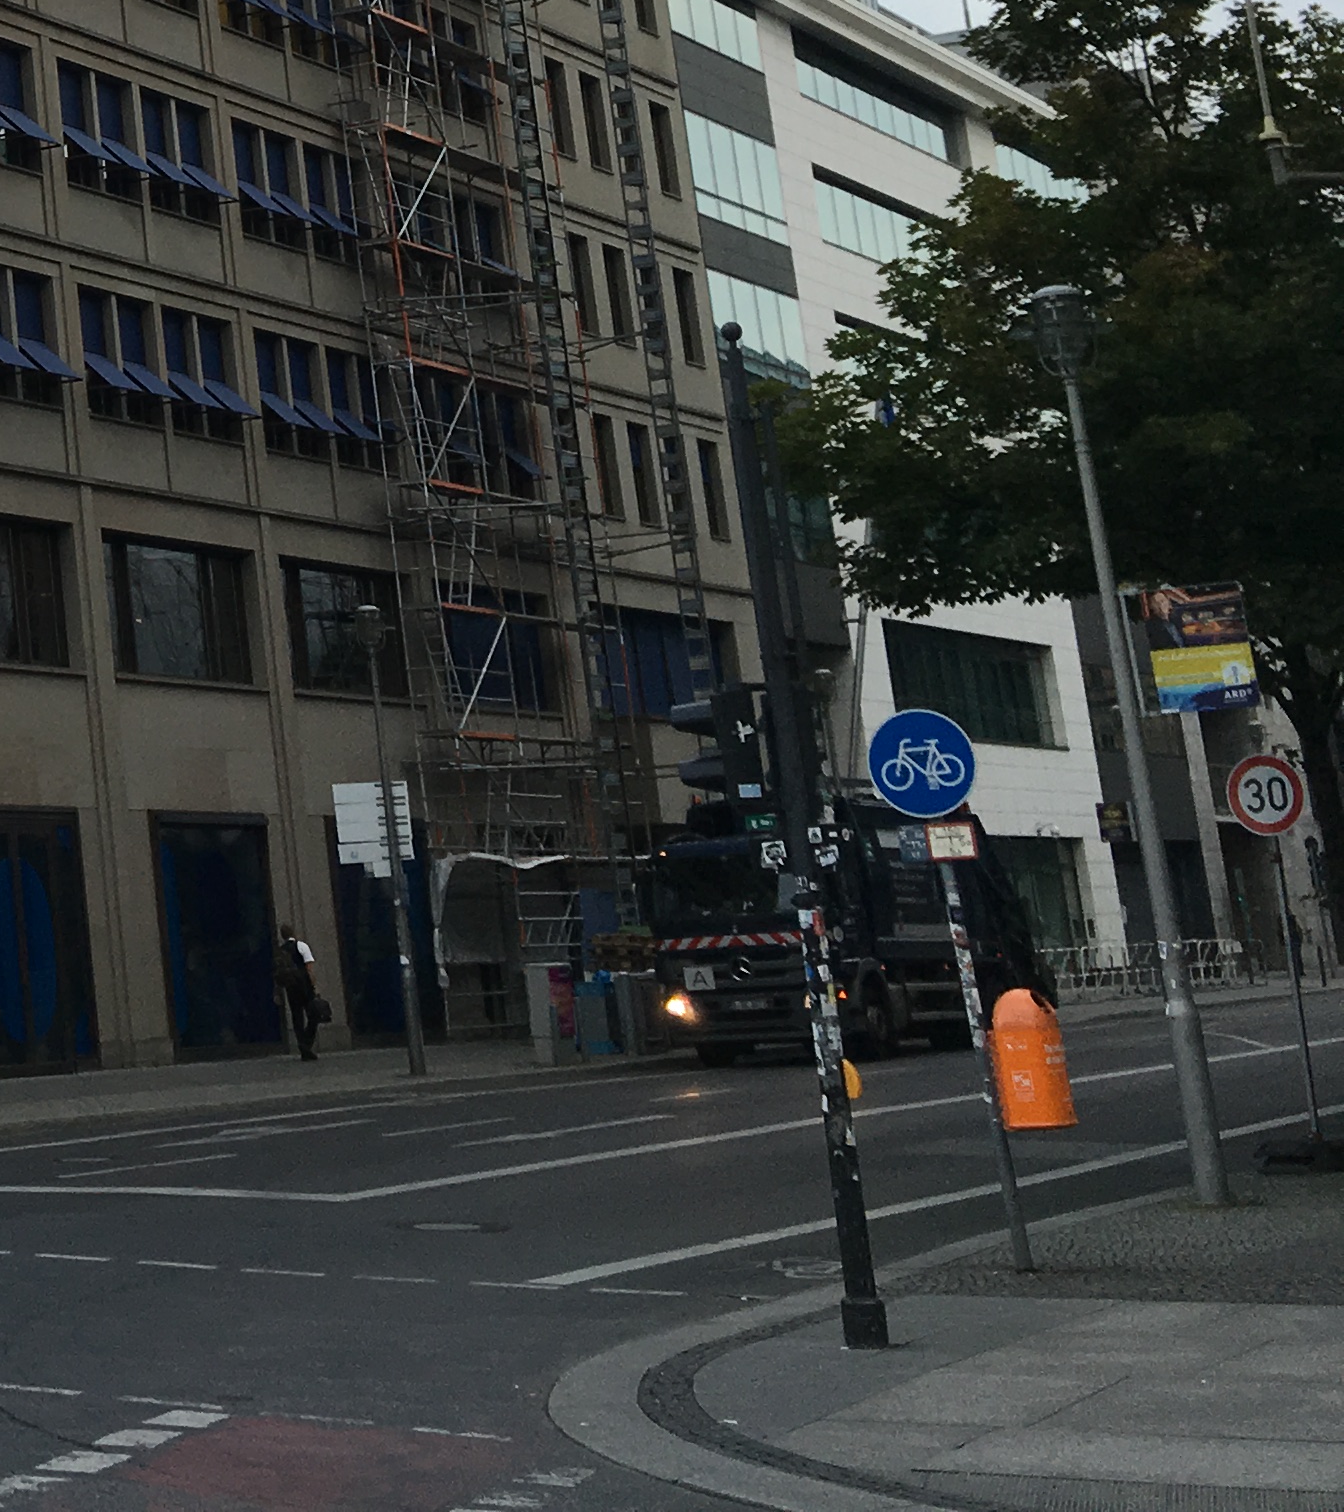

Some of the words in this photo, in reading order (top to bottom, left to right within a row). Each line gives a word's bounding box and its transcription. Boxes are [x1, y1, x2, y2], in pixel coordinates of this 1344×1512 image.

[1224, 689, 1247, 699] ARD
[1243, 777, 1291, 815] 30
[692, 971, 711, 988] A
